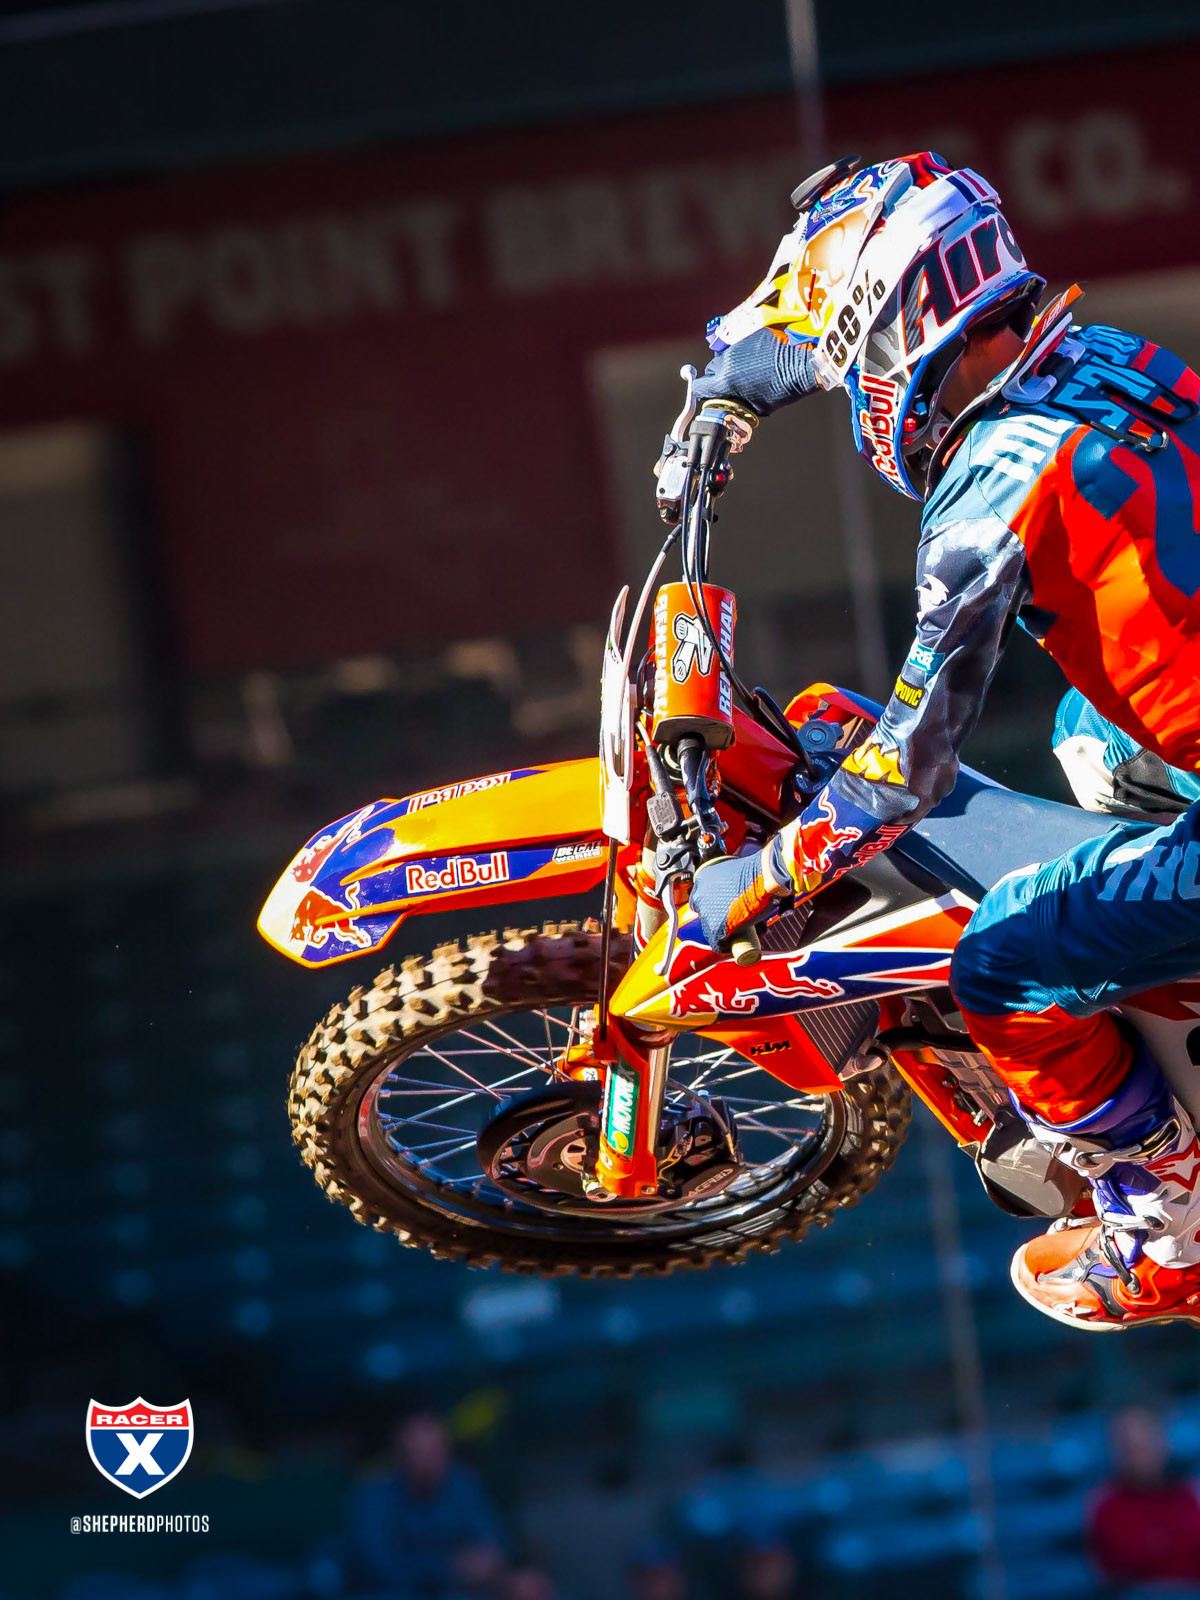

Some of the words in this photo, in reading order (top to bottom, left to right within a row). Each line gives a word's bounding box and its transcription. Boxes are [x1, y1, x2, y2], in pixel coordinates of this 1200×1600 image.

[128, 195, 462, 350] POINT
[1004, 110, 1191, 229] CO.
[750, 1039, 790, 1056] KTM
